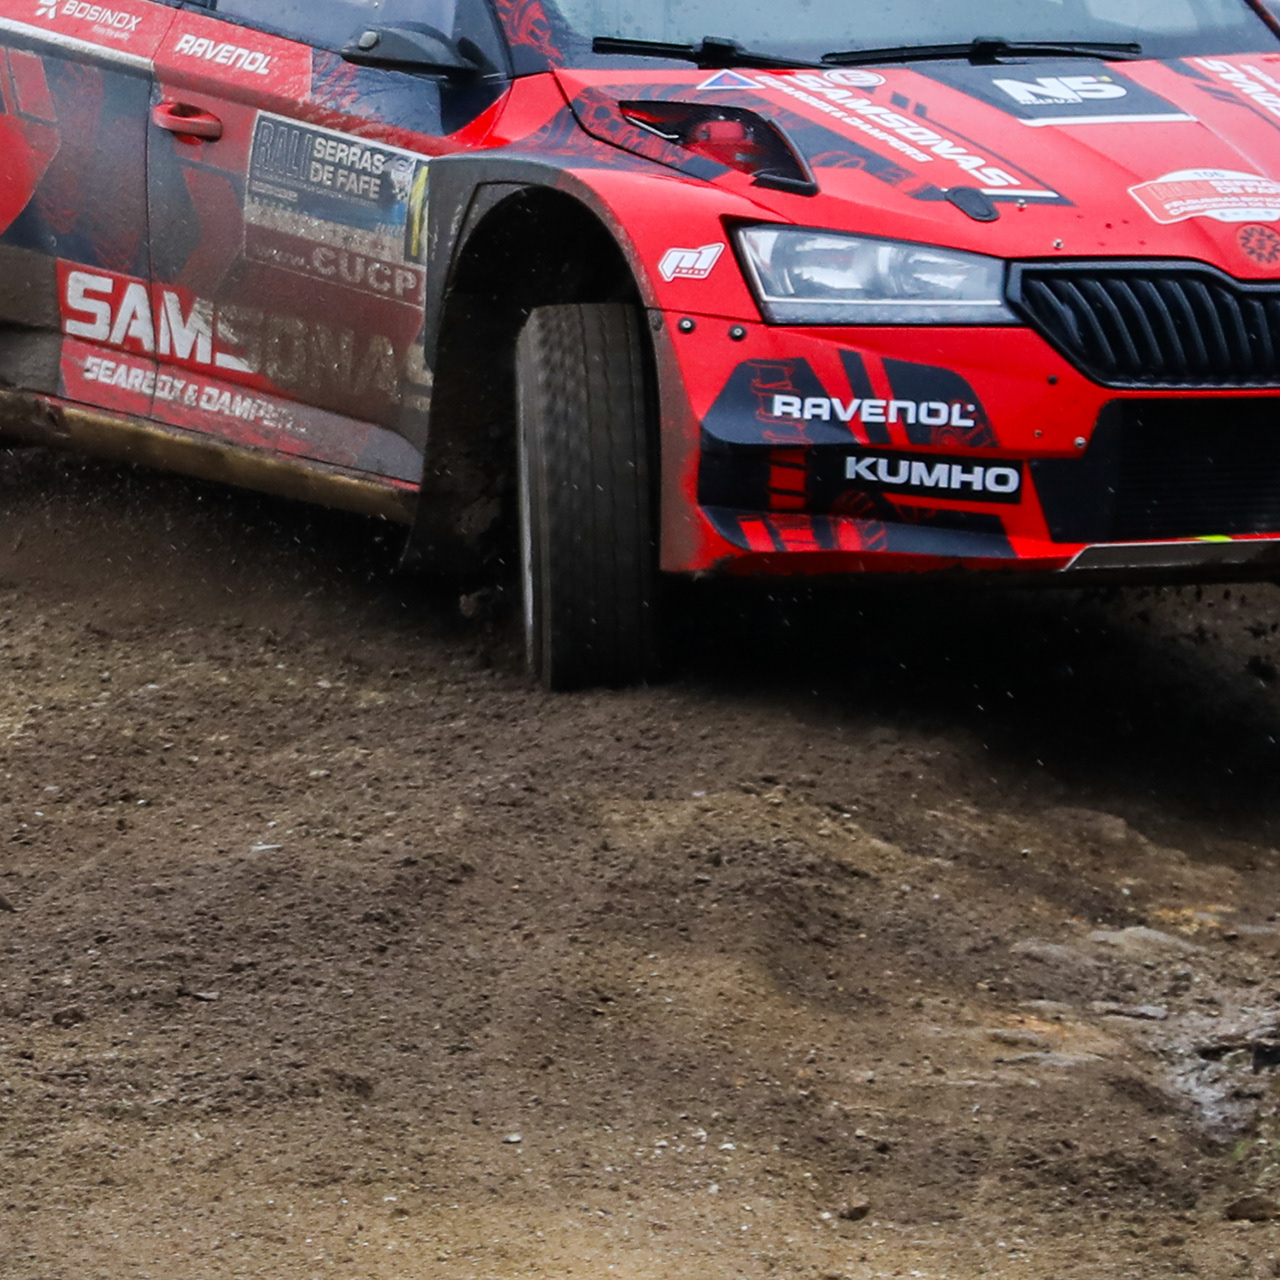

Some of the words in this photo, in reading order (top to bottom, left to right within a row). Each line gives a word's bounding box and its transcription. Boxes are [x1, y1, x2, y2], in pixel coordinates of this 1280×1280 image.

[61, 0, 142, 32] BOSINOX
[175, 34, 278, 75] RAVENOL
[992, 75, 1127, 104] N5
[755, 75, 840, 112] GEARBOX
[841, 116, 934, 162] DAMPERS
[782, 74, 1021, 186] SAMSONAS
[253, 121, 313, 180] RALI
[313, 137, 385, 175] SERRAS
[310, 161, 334, 187] DE
[336, 170, 381, 199] FAFE
[183, 385, 198, 407] &
[773, 394, 975, 427] RAVENOL
[845, 456, 1020, 493] KUMHO
